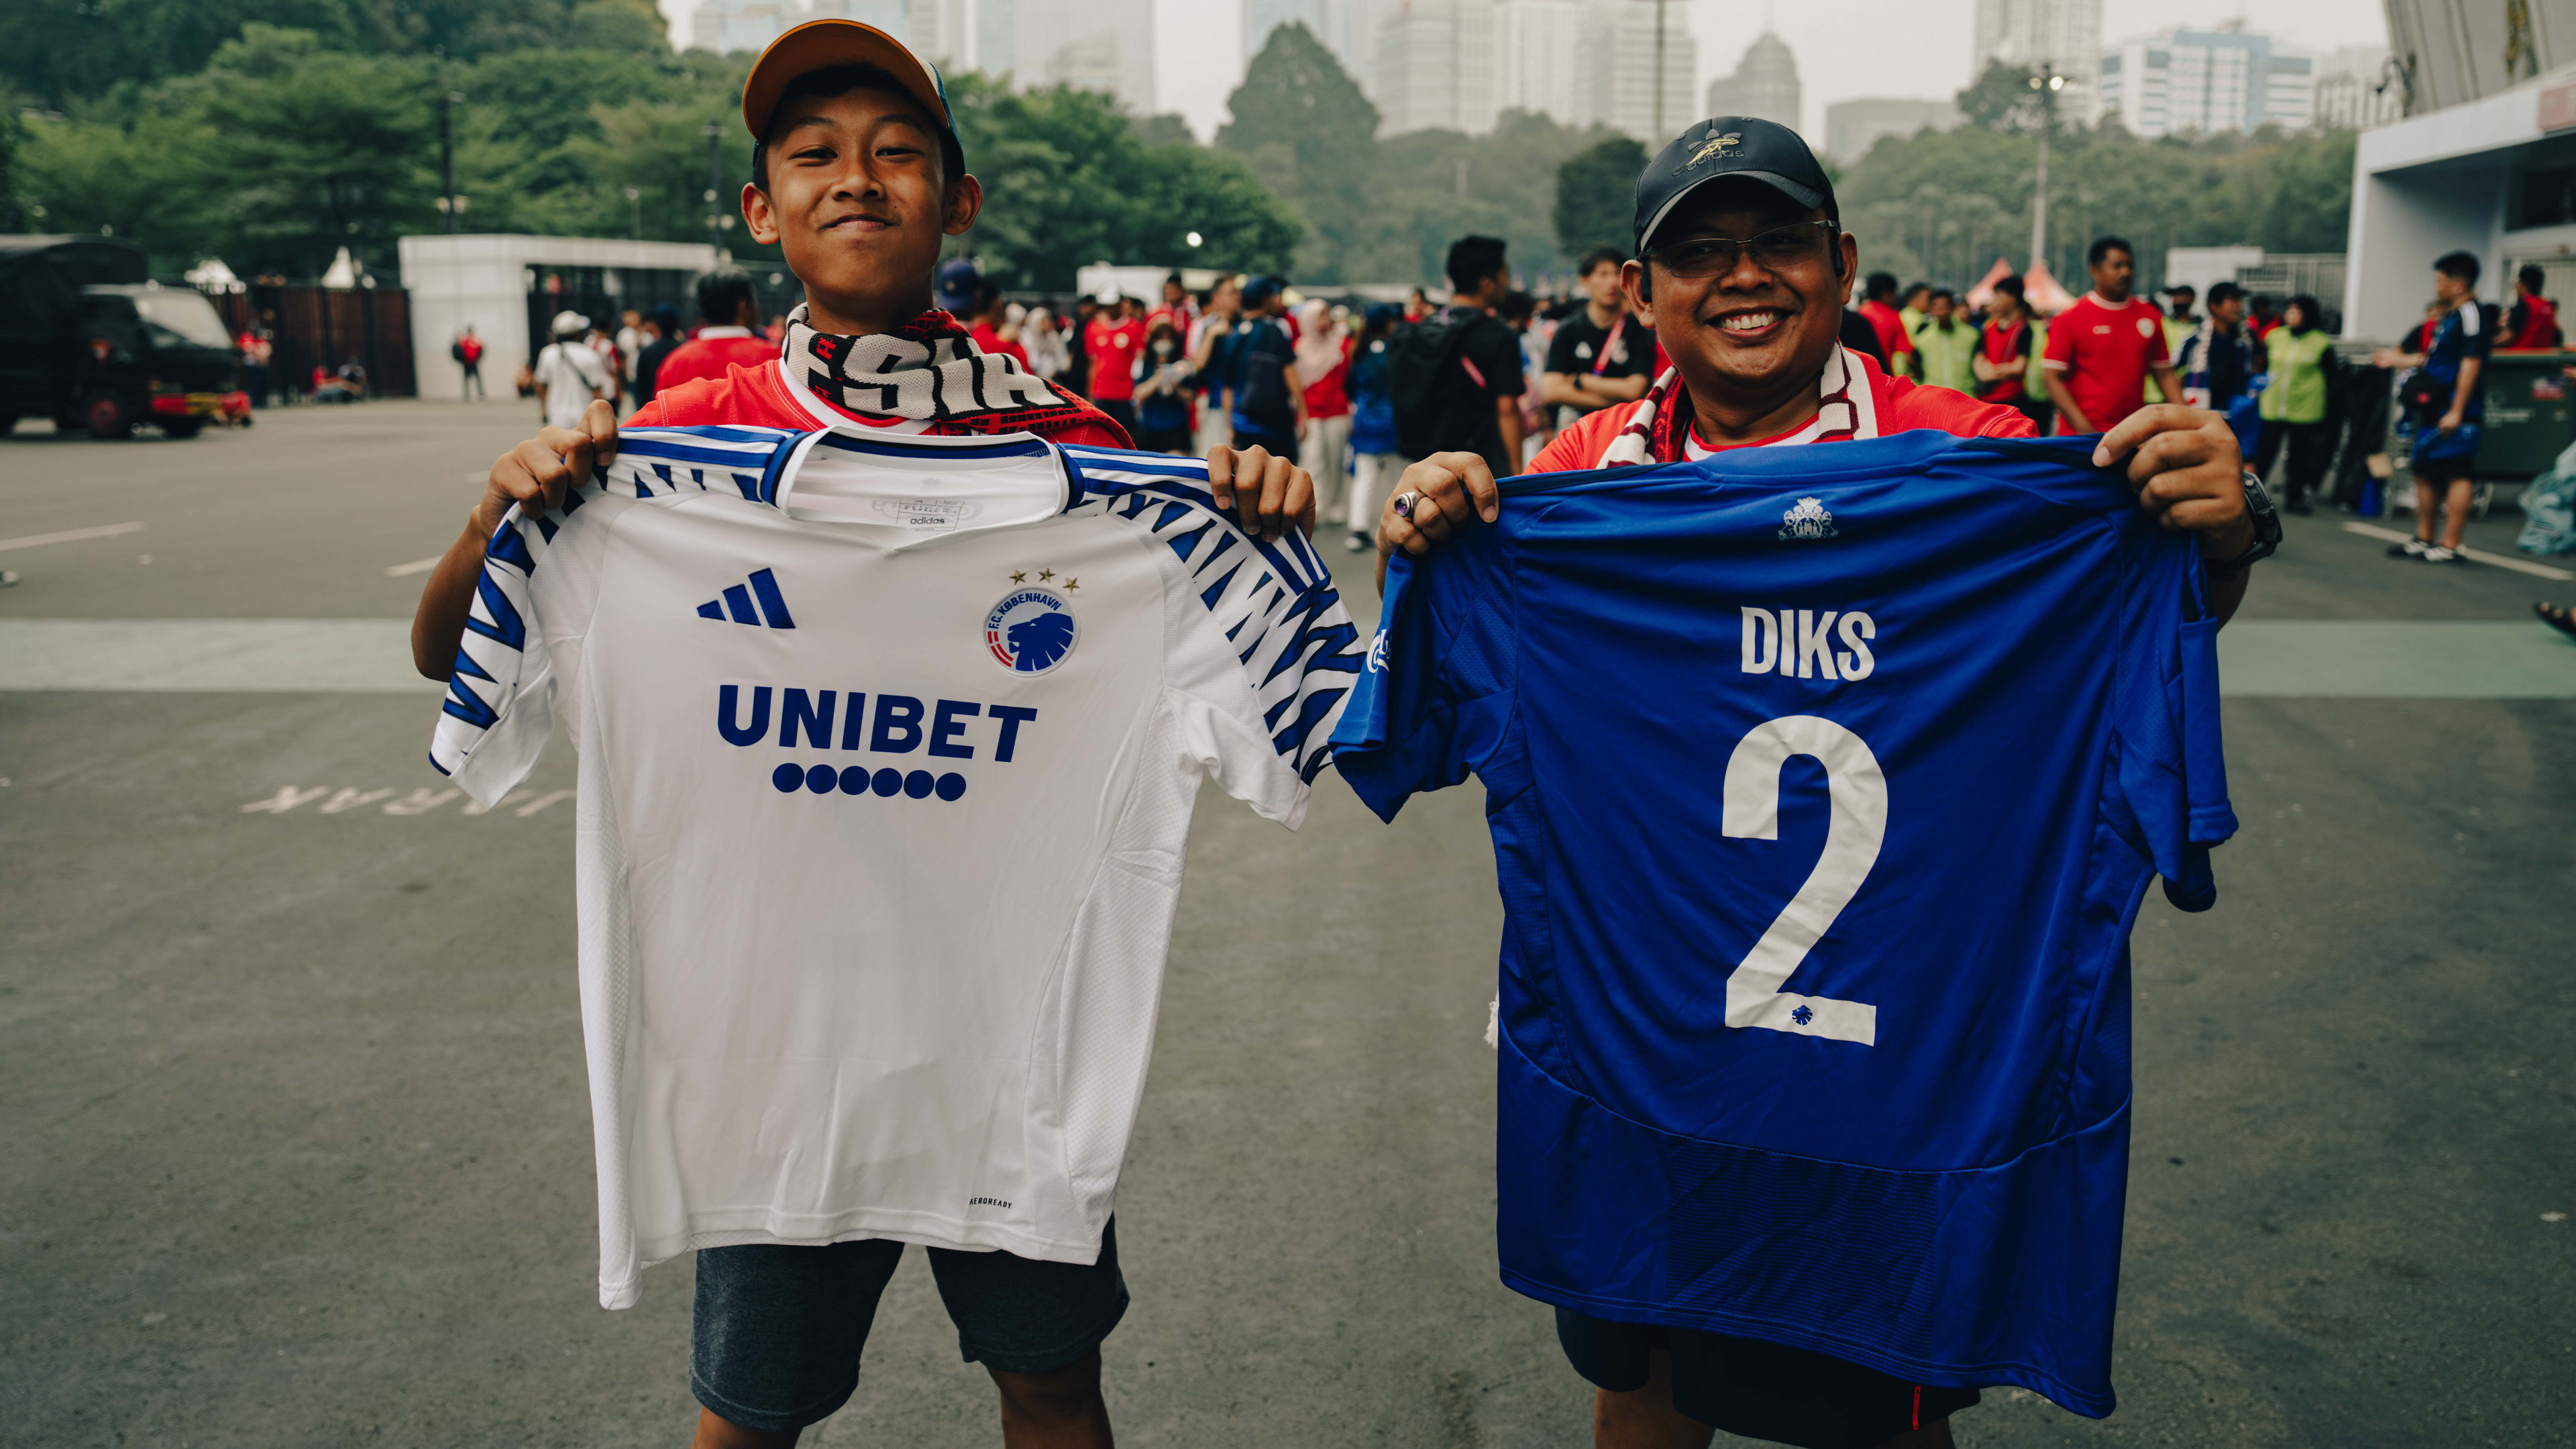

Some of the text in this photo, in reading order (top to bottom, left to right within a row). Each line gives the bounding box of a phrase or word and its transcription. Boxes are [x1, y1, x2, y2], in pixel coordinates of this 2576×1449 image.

[910, 517, 945, 525] adidas
[987, 592, 1063, 629] F.C. KØBENHAVN
[1741, 607, 1875, 681] DIKS
[718, 685, 1037, 762] UNIBET
[1722, 715, 1888, 1046] 2
[969, 1197, 1012, 1209] AEROREADY
